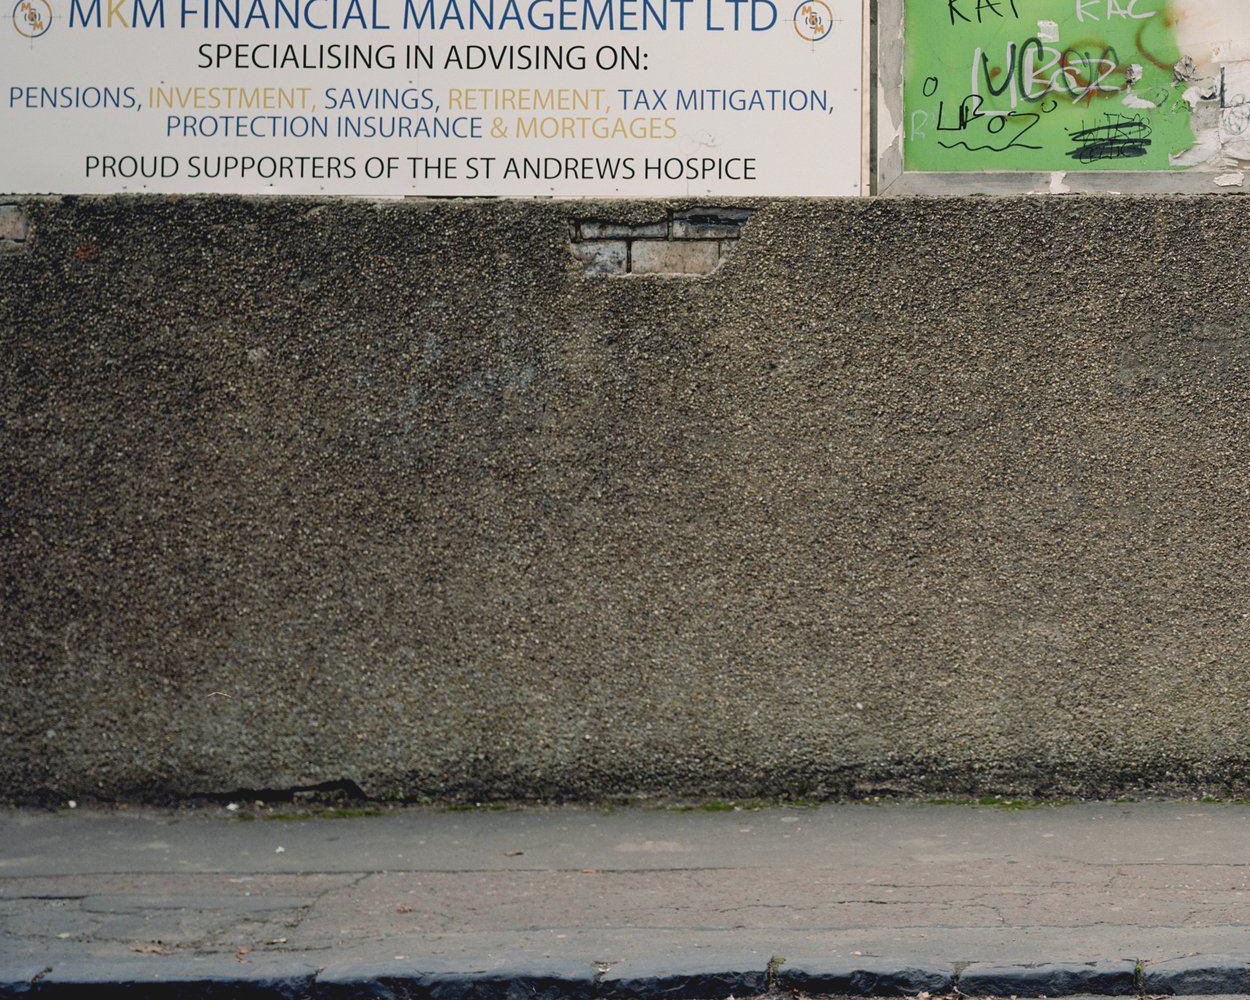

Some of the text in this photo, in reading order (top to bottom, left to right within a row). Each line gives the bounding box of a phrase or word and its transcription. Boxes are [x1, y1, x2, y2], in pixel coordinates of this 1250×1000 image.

[706, 0, 778, 31] LTD
[198, 43, 649, 71] SPECIALISING IN ADVISING ON:
[9, 87, 834, 114] PENSIONS, INVESTMENT, SAVINGS, RETIREMENT, TAX MITIGATION,
[166, 115, 677, 140] PROTECTION INSURANCE & MORTGAGES
[85, 156, 757, 181] PROUD SUPPORTERS OF THE ST ANDREWS HOSPICE
